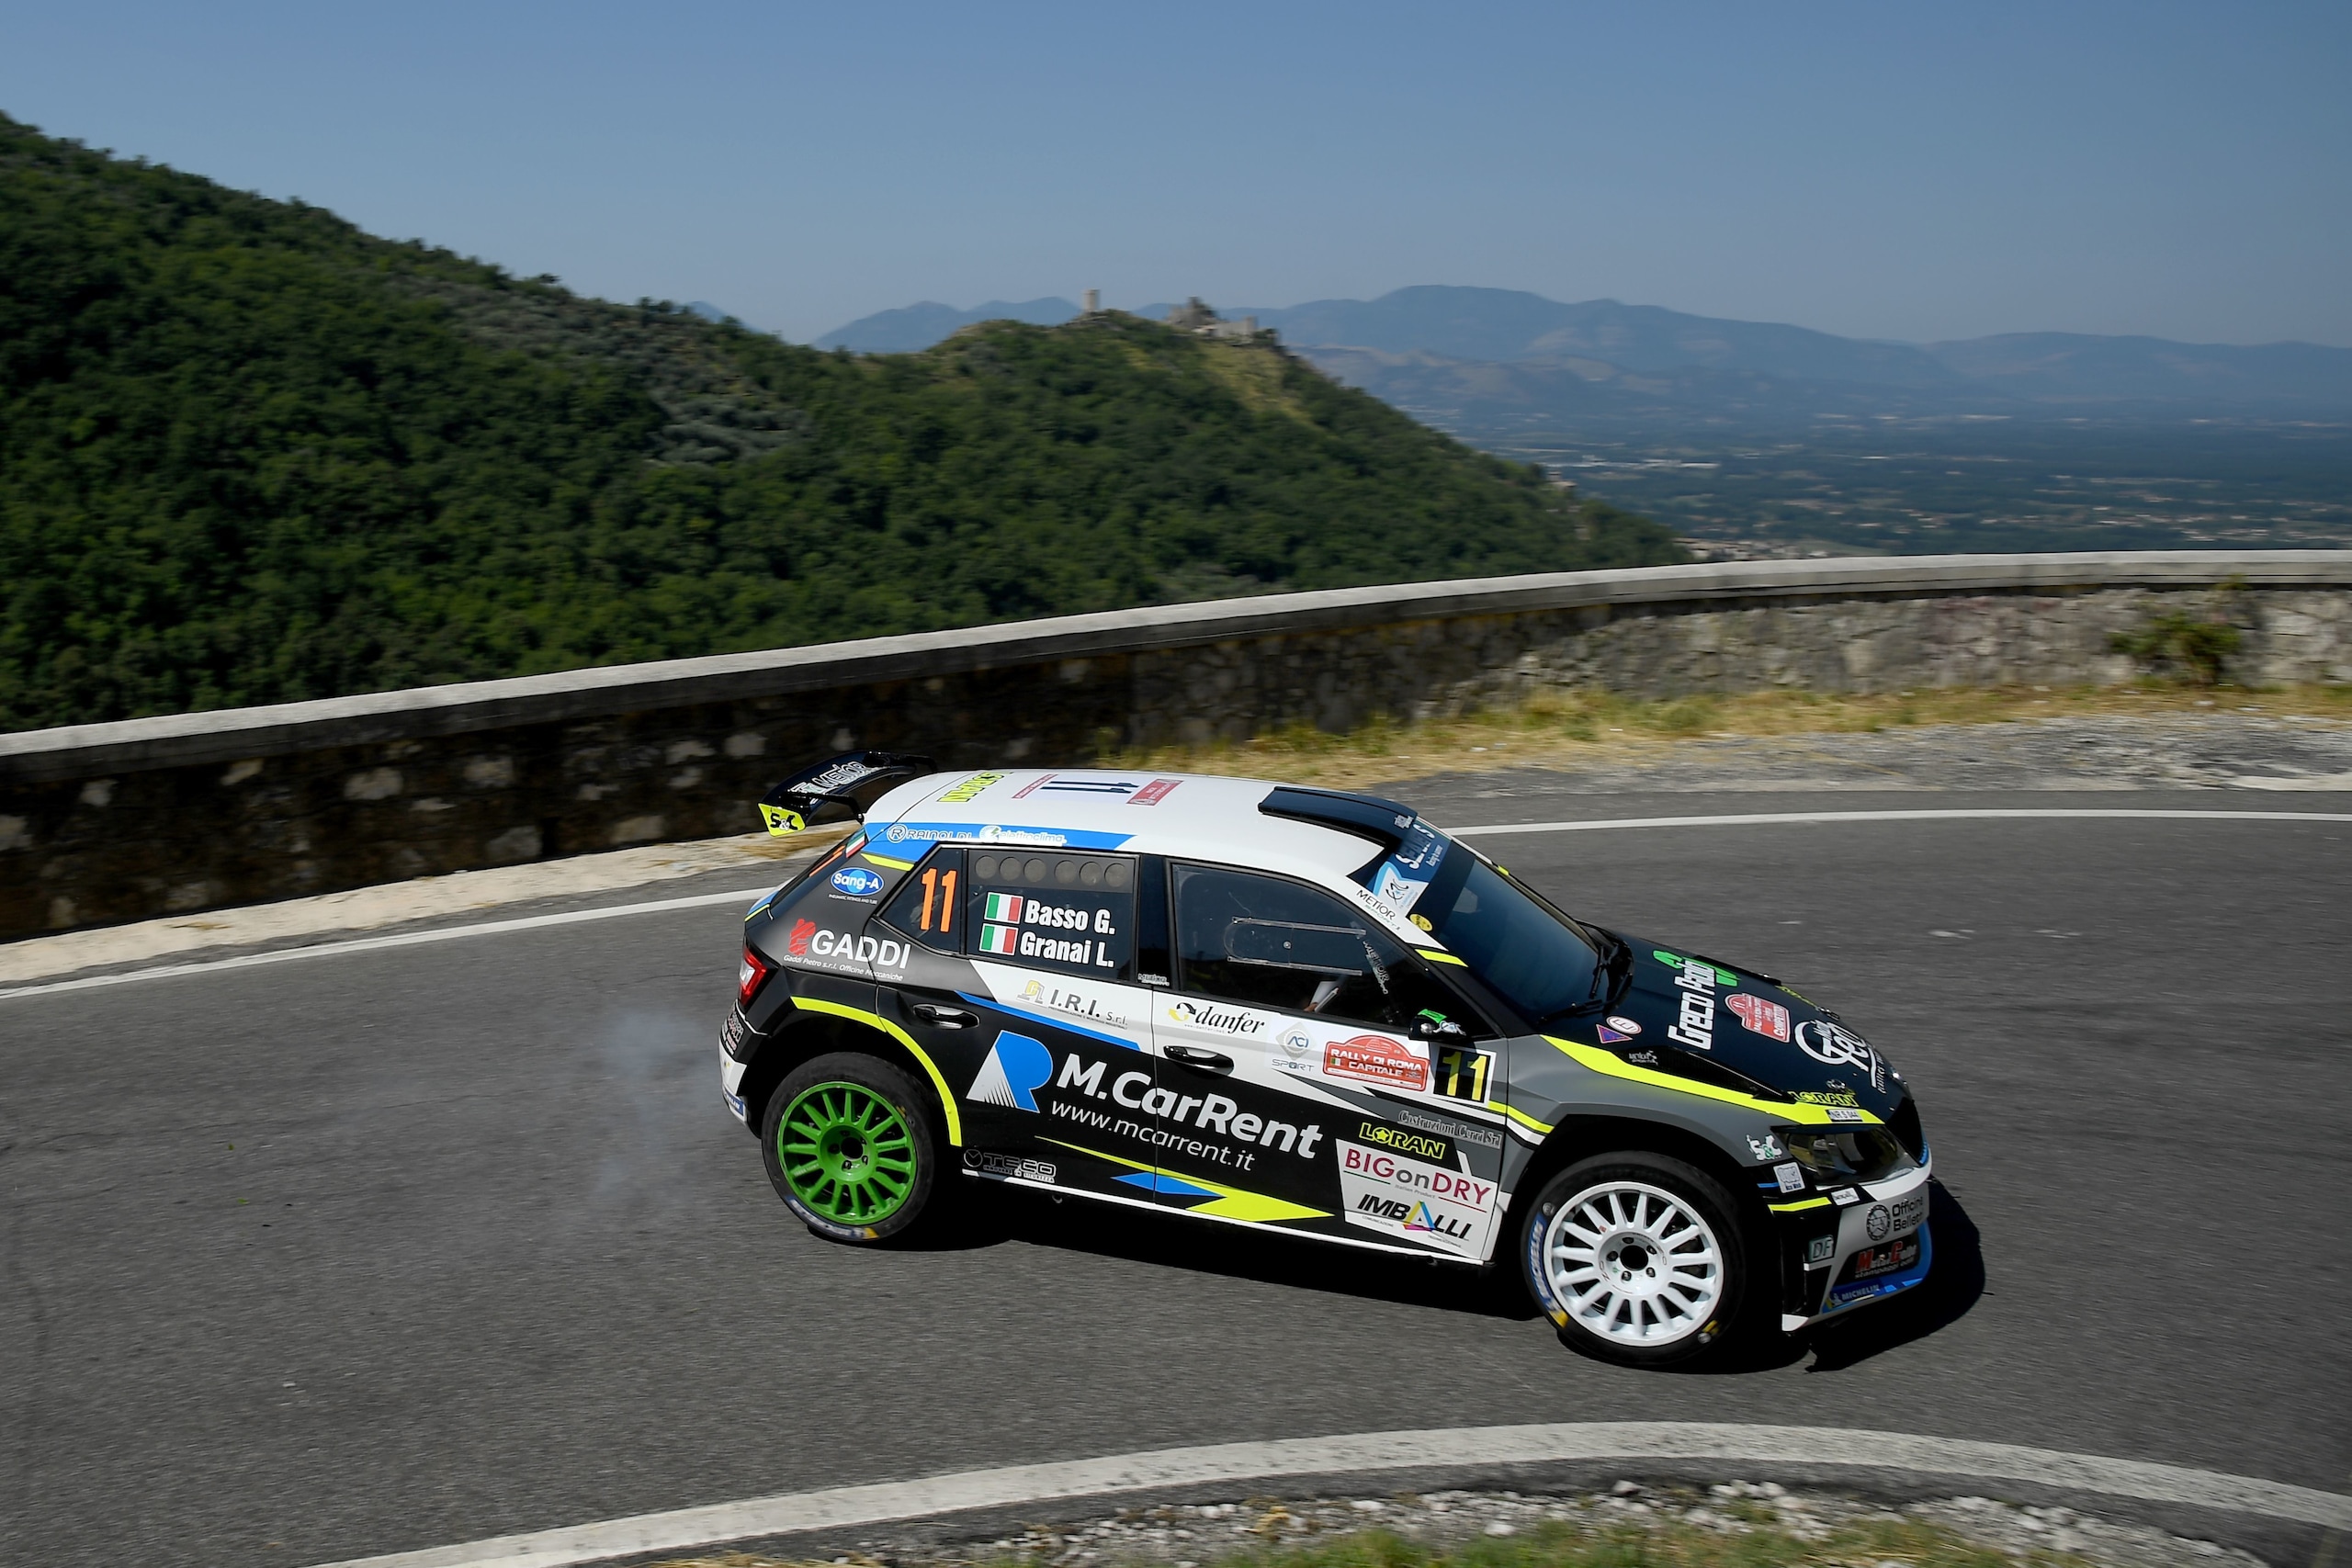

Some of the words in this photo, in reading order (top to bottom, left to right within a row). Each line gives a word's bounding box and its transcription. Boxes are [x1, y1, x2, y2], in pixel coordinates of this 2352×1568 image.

[832, 873, 879, 890] Sang-A
[921, 867, 957, 932] 11
[1024, 899, 1089, 931] Basso
[1093, 908, 1116, 935] G.
[811, 929, 911, 969] GADDI
[1020, 931, 1091, 964] Granai
[1095, 942, 1114, 968] L.
[784, 954, 802, 964] Gaddi
[803, 957, 821, 967] Pietro
[822, 961, 837, 970] s.r.l.
[839, 964, 864, 975] Officine
[865, 969, 903, 982] Meccaniche
[1050, 989, 1101, 1018] I.R.I.
[1195, 1007, 1265, 1034] danfer
[1668, 992, 1715, 1050] Greco
[1287, 1035, 1309, 1048] ACI
[1330, 1048, 1371, 1061] RALLY
[1373, 1056, 1385, 1065] DI
[1386, 1058, 1422, 1071] ROMA
[1272, 1059, 1315, 1072] SPORT
[1348, 1062, 1403, 1077] CAPITALE
[1442, 1051, 1487, 1101] 11
[1057, 1053, 1323, 1159] M.CarRent
[1052, 1101, 1256, 1171] www.mcarrent.it
[1359, 1122, 1446, 1159] LORAN
[984, 1153, 1057, 1177] TECO
[1345, 1148, 1491, 1204] BIGonDRY
[1357, 1194, 1472, 1239] IMBALLI
[1841, 1284, 1880, 1300] MICHELIN
